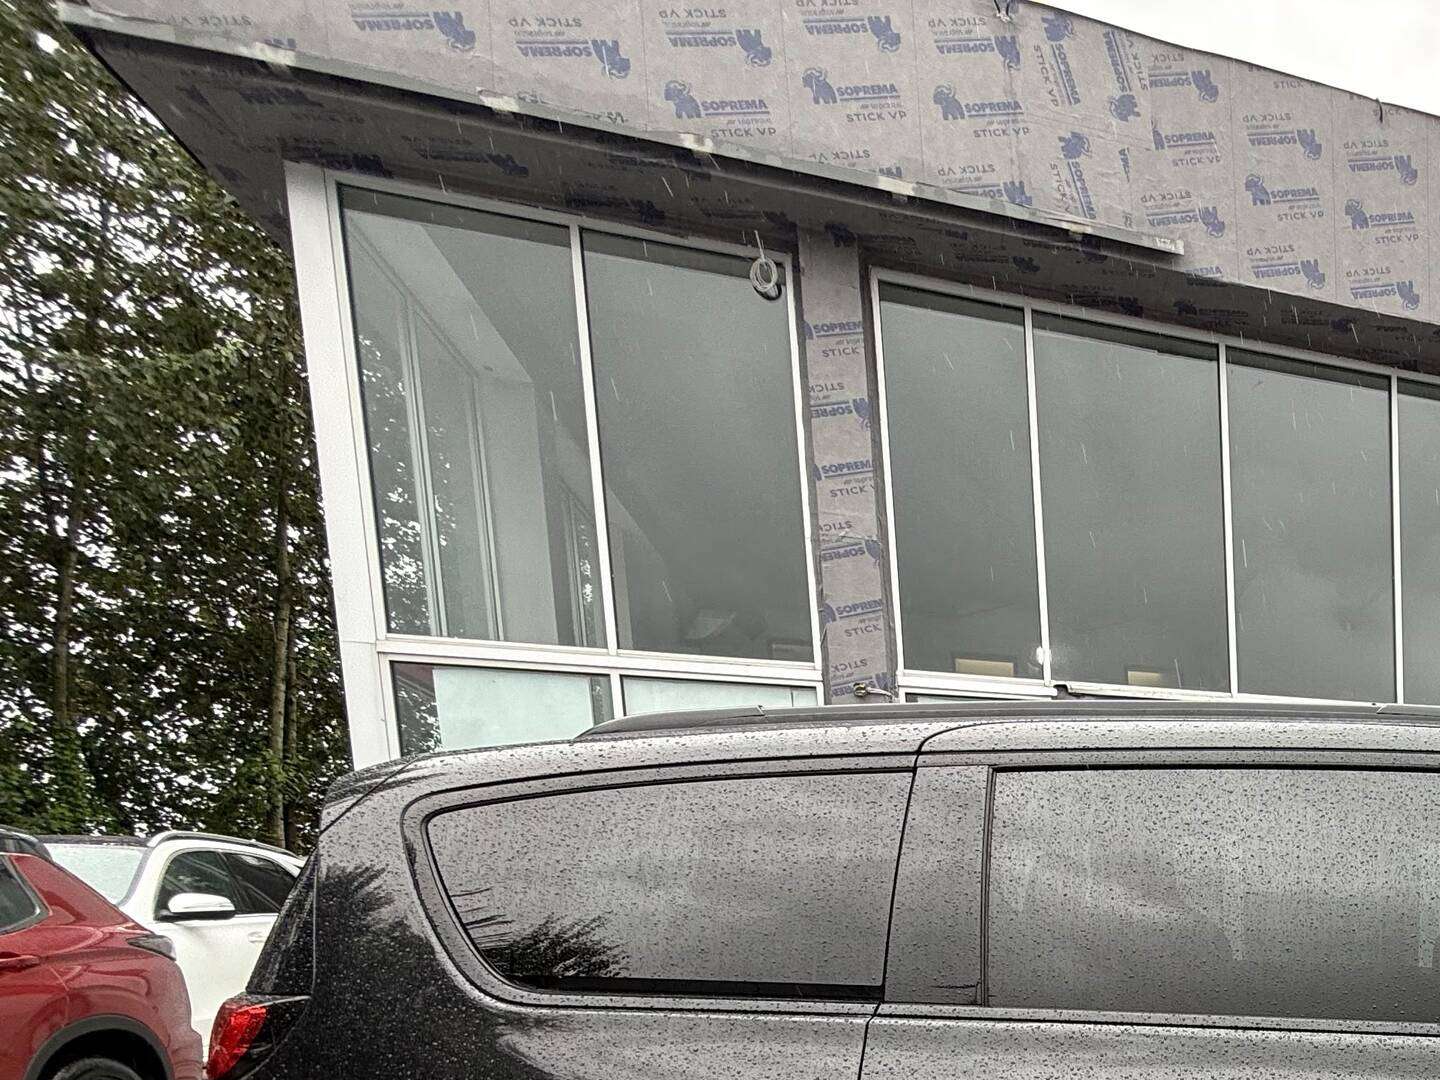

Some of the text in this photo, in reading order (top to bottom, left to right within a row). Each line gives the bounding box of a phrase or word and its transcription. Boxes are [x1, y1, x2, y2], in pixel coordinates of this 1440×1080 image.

[813, 321, 863, 334] SOPREM
[811, 406, 853, 418] SOPRE
[821, 460, 873, 475] SOPREM
